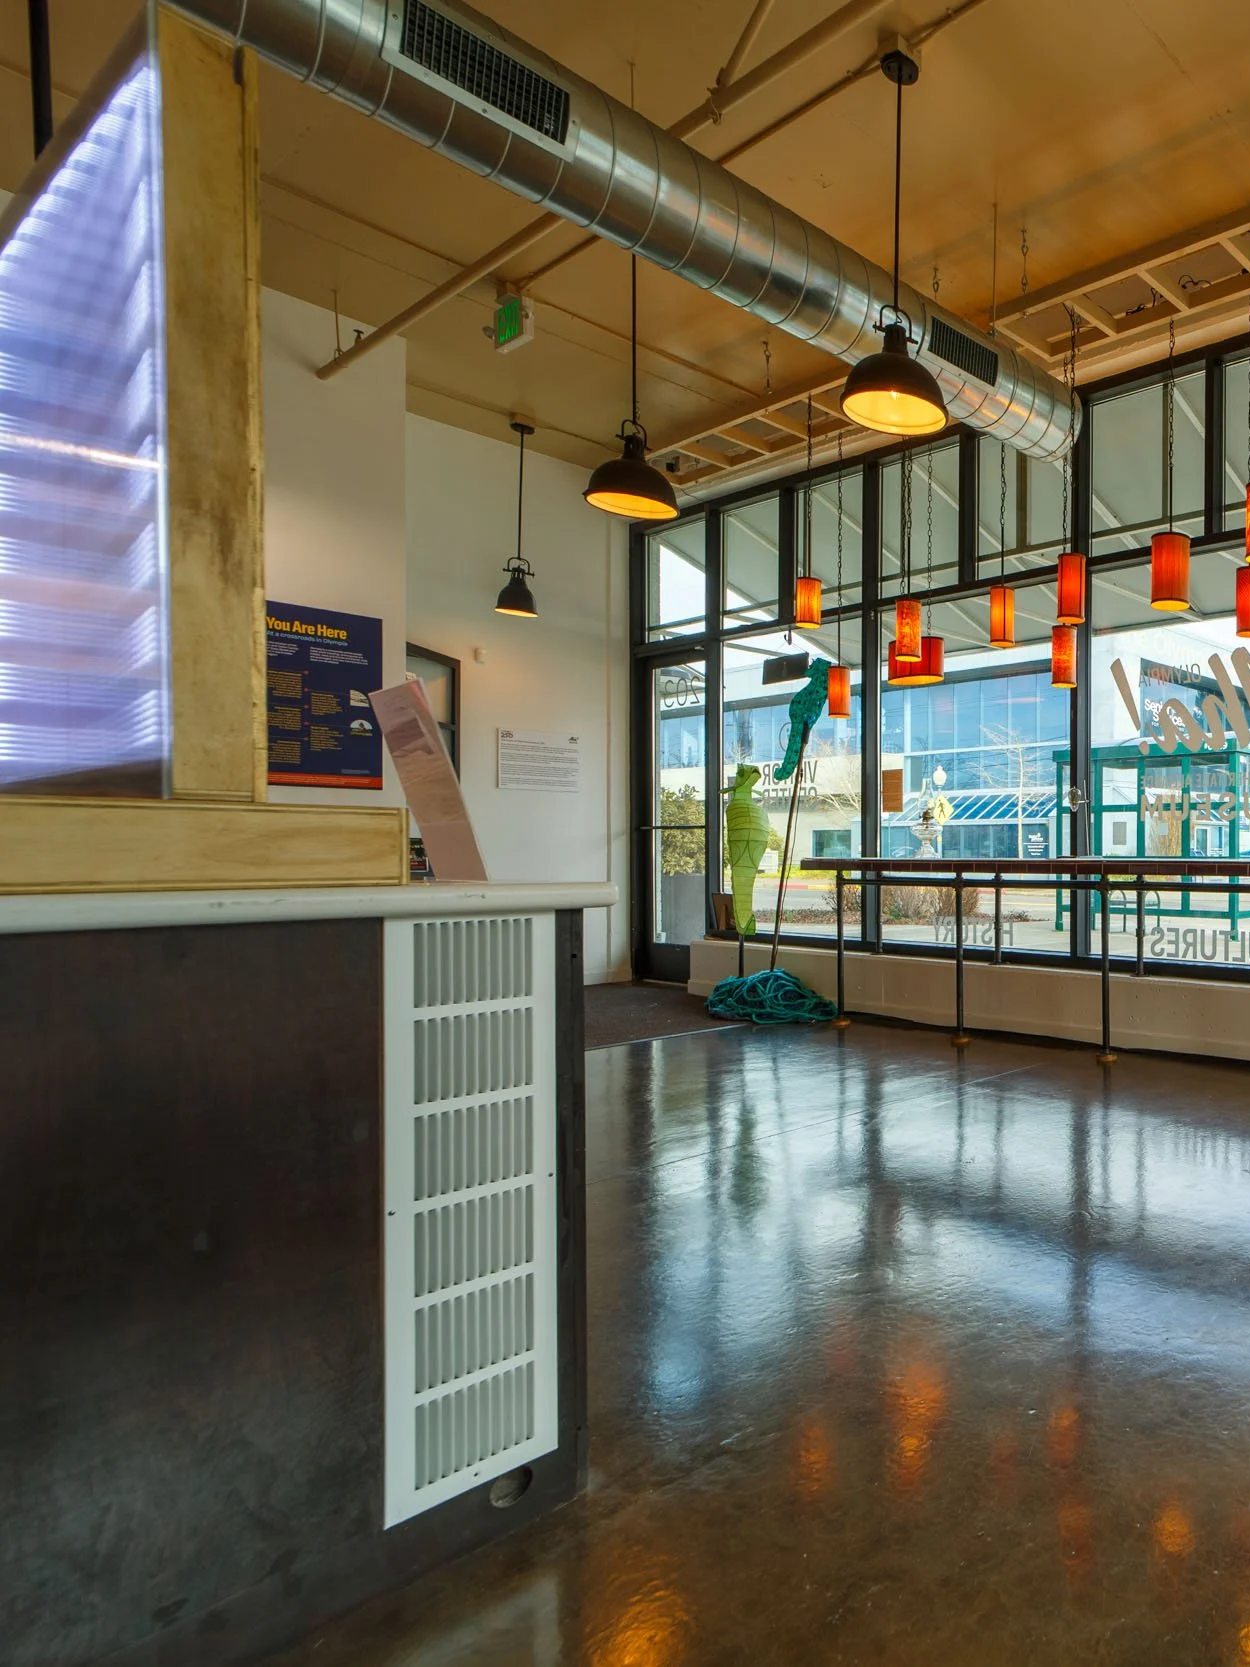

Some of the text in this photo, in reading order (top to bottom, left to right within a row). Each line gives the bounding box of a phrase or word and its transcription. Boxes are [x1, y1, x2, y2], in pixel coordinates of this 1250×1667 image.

[498, 300, 520, 344] EXIT
[266, 616, 347, 640] You Are Here
[280, 633, 315, 642] crossroads
[323, 638, 349, 647] Olympia
